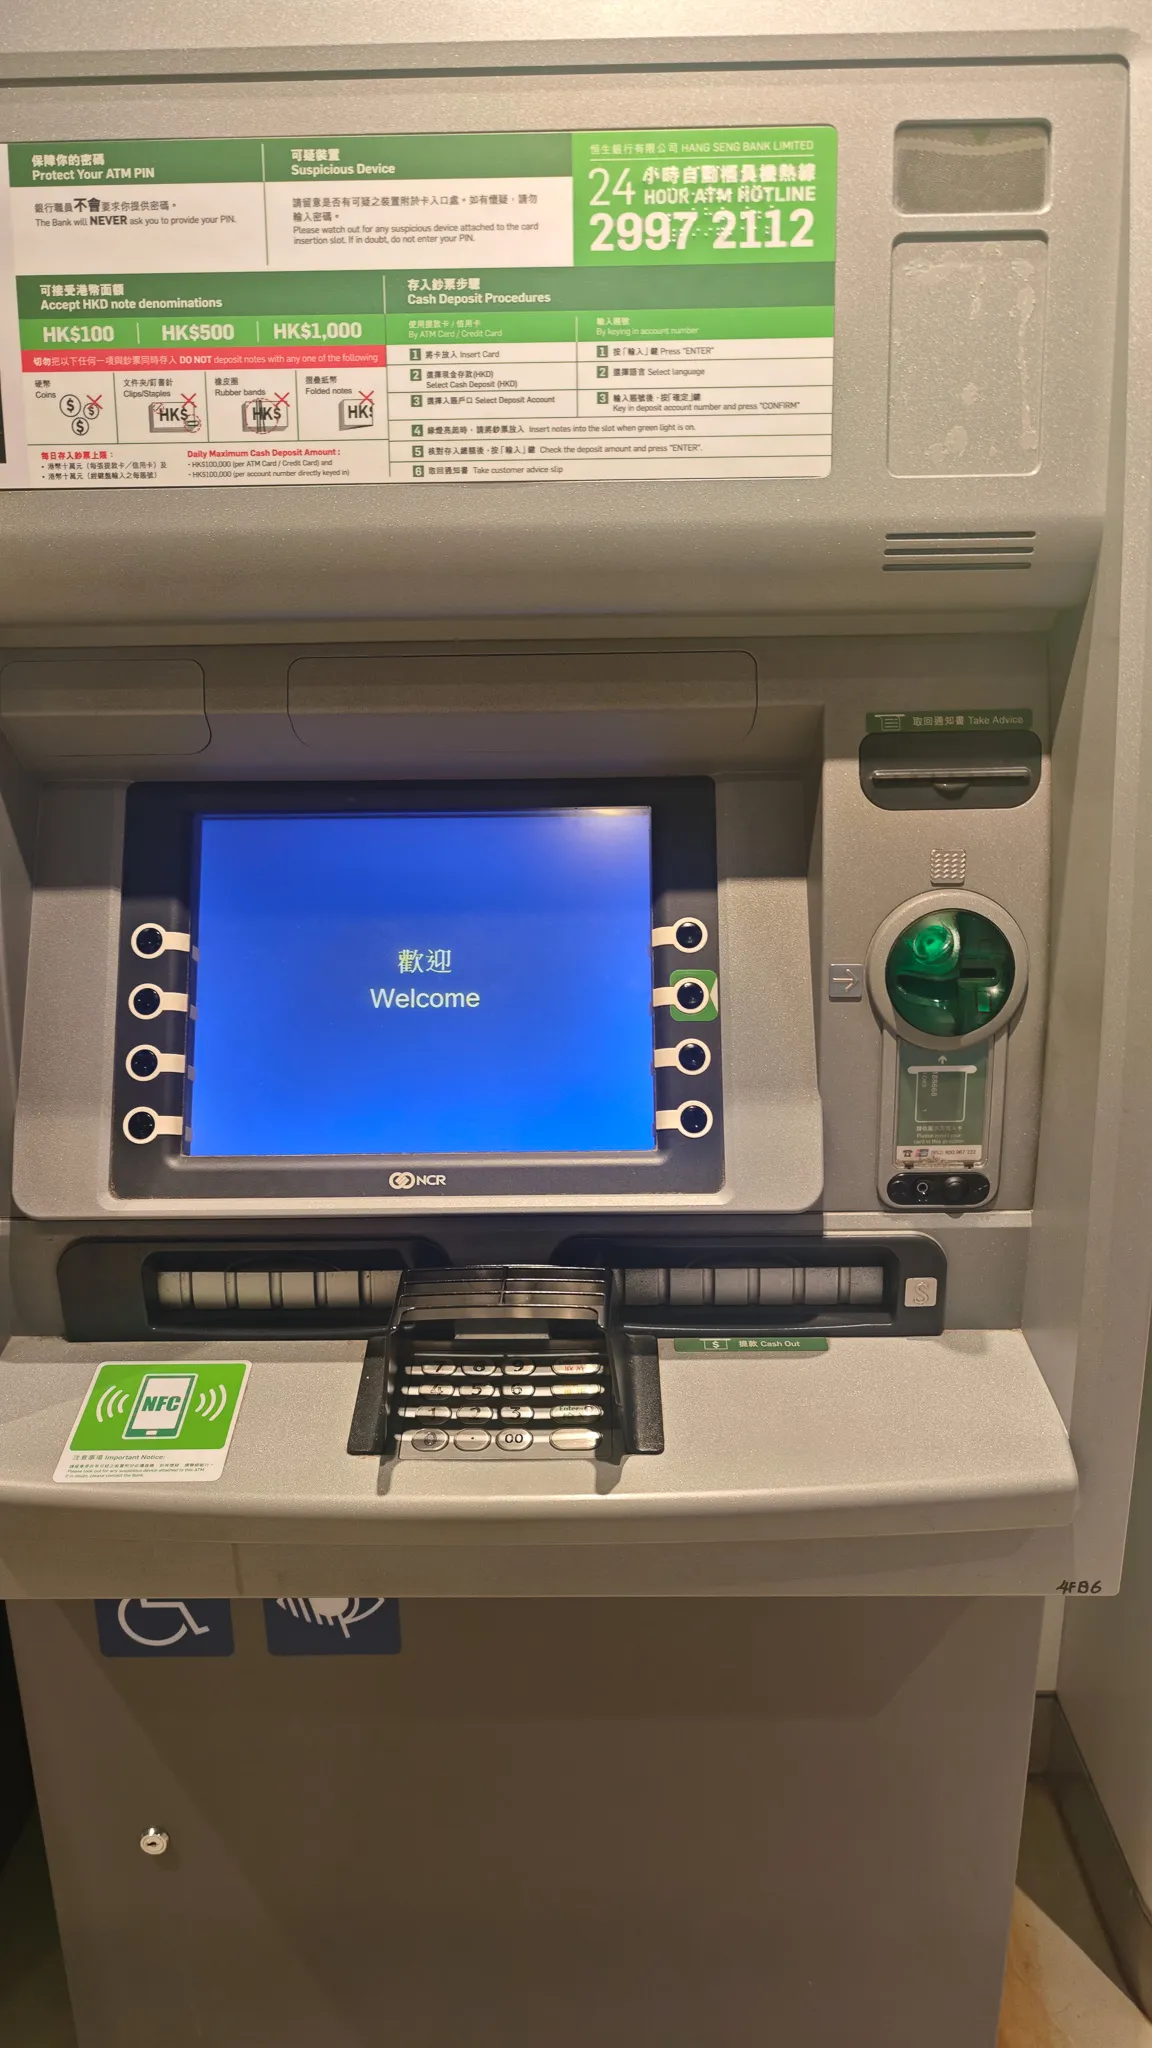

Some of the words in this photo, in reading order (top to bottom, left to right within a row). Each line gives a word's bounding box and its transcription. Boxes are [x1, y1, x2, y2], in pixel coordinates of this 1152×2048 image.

[681, 143, 711, 152] HANG
[712, 142, 740, 152] SENG
[743, 142, 771, 151] BANK
[773, 140, 814, 150] LIMITED
[32, 154, 105, 166] 保障你的密碼
[290, 149, 340, 161] 可疑裝置
[32, 170, 75, 180] Protect
[76, 169, 103, 179] Your
[106, 168, 131, 178] ATM
[134, 168, 155, 178] PIN
[291, 164, 354, 176] Suspicious
[357, 163, 395, 174] Device
[589, 168, 636, 205] 24
[644, 188, 689, 204] HOUR
[694, 189, 732, 202] ATM
[737, 185, 816, 202] HOTLINE
[74, 218, 88, 226] will
[90, 215, 127, 225] NEVER
[171, 216, 199, 225] provide
[293, 212, 338, 221] 輸入密碼。
[293, 226, 320, 234] Please
[362, 225, 373, 233] for
[590, 212, 698, 251] 2997
[712, 208, 814, 248] 2112
[440, 236, 457, 244] your
[40, 284, 124, 296] 可接受港幣面額
[407, 278, 480, 291] 存入鈔票步驟
[41, 300, 81, 311] Accept
[83, 299, 108, 309] HKD
[111, 299, 136, 309] note
[138, 298, 223, 308] denominations
[408, 294, 436, 304] Cash
[439, 293, 483, 305] Deposit
[485, 293, 551, 303] Procedures
[43, 326, 114, 342] HK$100
[162, 324, 234, 340] HK$500
[274, 322, 362, 339] HK$1,000
[596, 328, 606, 337] By
[607, 328, 631, 336] keying
[426, 351, 457, 359] 將卡放入
[497, 380, 517, 388] (HKD)
[124, 390, 171, 398] Clips/Staples
[187, 451, 207, 459] Daily
[209, 451, 246, 459] Maximum
[272, 449, 302, 457] Deposit
[550, 466, 563, 474] slip
[912, 716, 964, 726] 取回通知書
[968, 716, 990, 724] Take
[992, 716, 1023, 724] Advice
[398, 949, 451, 973] 歡迎
[370, 989, 480, 1008] Welcome
[416, 1175, 446, 1185] NCR
[513, 1361, 524, 1372] 9
[511, 1385, 522, 1395] 6
[142, 1396, 181, 1412] NFC
[470, 1407, 481, 1418] 2
[510, 1407, 521, 1418] 3
[505, 1434, 523, 1444] 00
